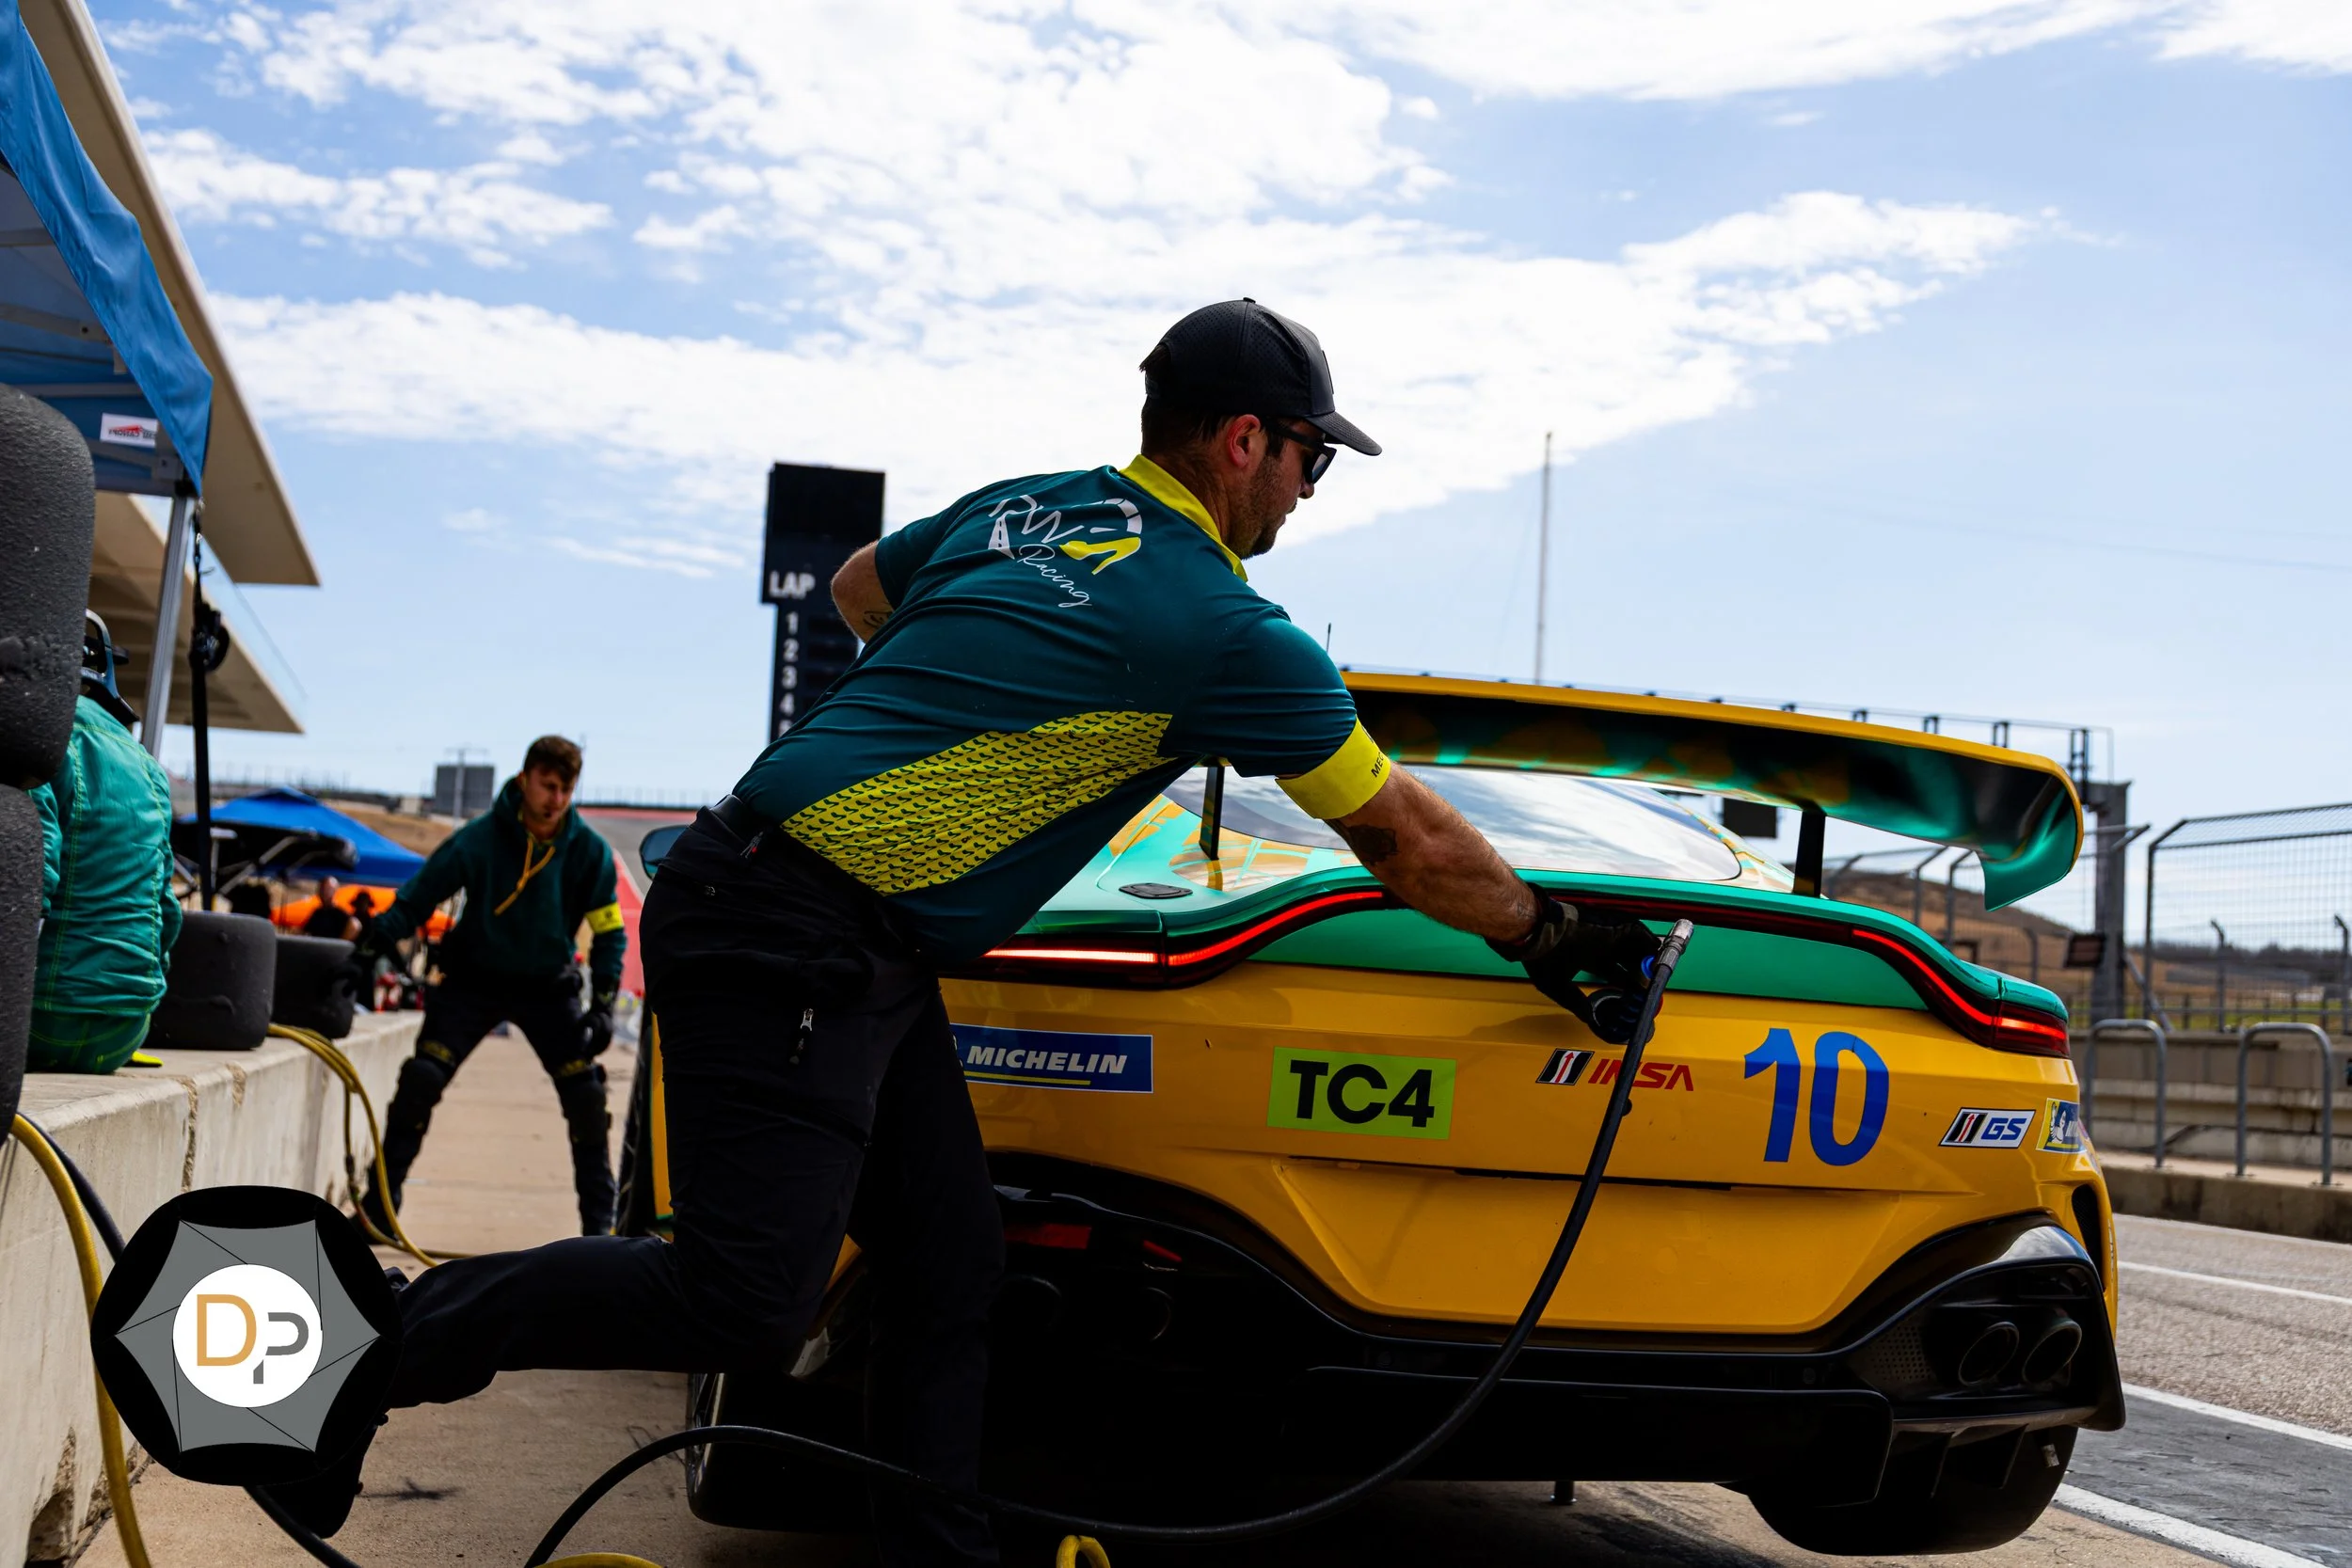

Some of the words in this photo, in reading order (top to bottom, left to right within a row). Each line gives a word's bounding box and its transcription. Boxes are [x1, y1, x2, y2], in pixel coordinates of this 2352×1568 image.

[768, 570, 816, 599] LAP
[1017, 544, 1092, 608] Racing
[786, 611, 799, 635] 1
[784, 638, 799, 662] 2
[782, 665, 798, 689] 3
[779, 692, 795, 717] 4
[966, 1045, 1128, 1074] MICHELIN
[1290, 1059, 1435, 1128] TC4
[1744, 1028, 1889, 1166] 10
[1980, 1117, 2027, 1140] GS
